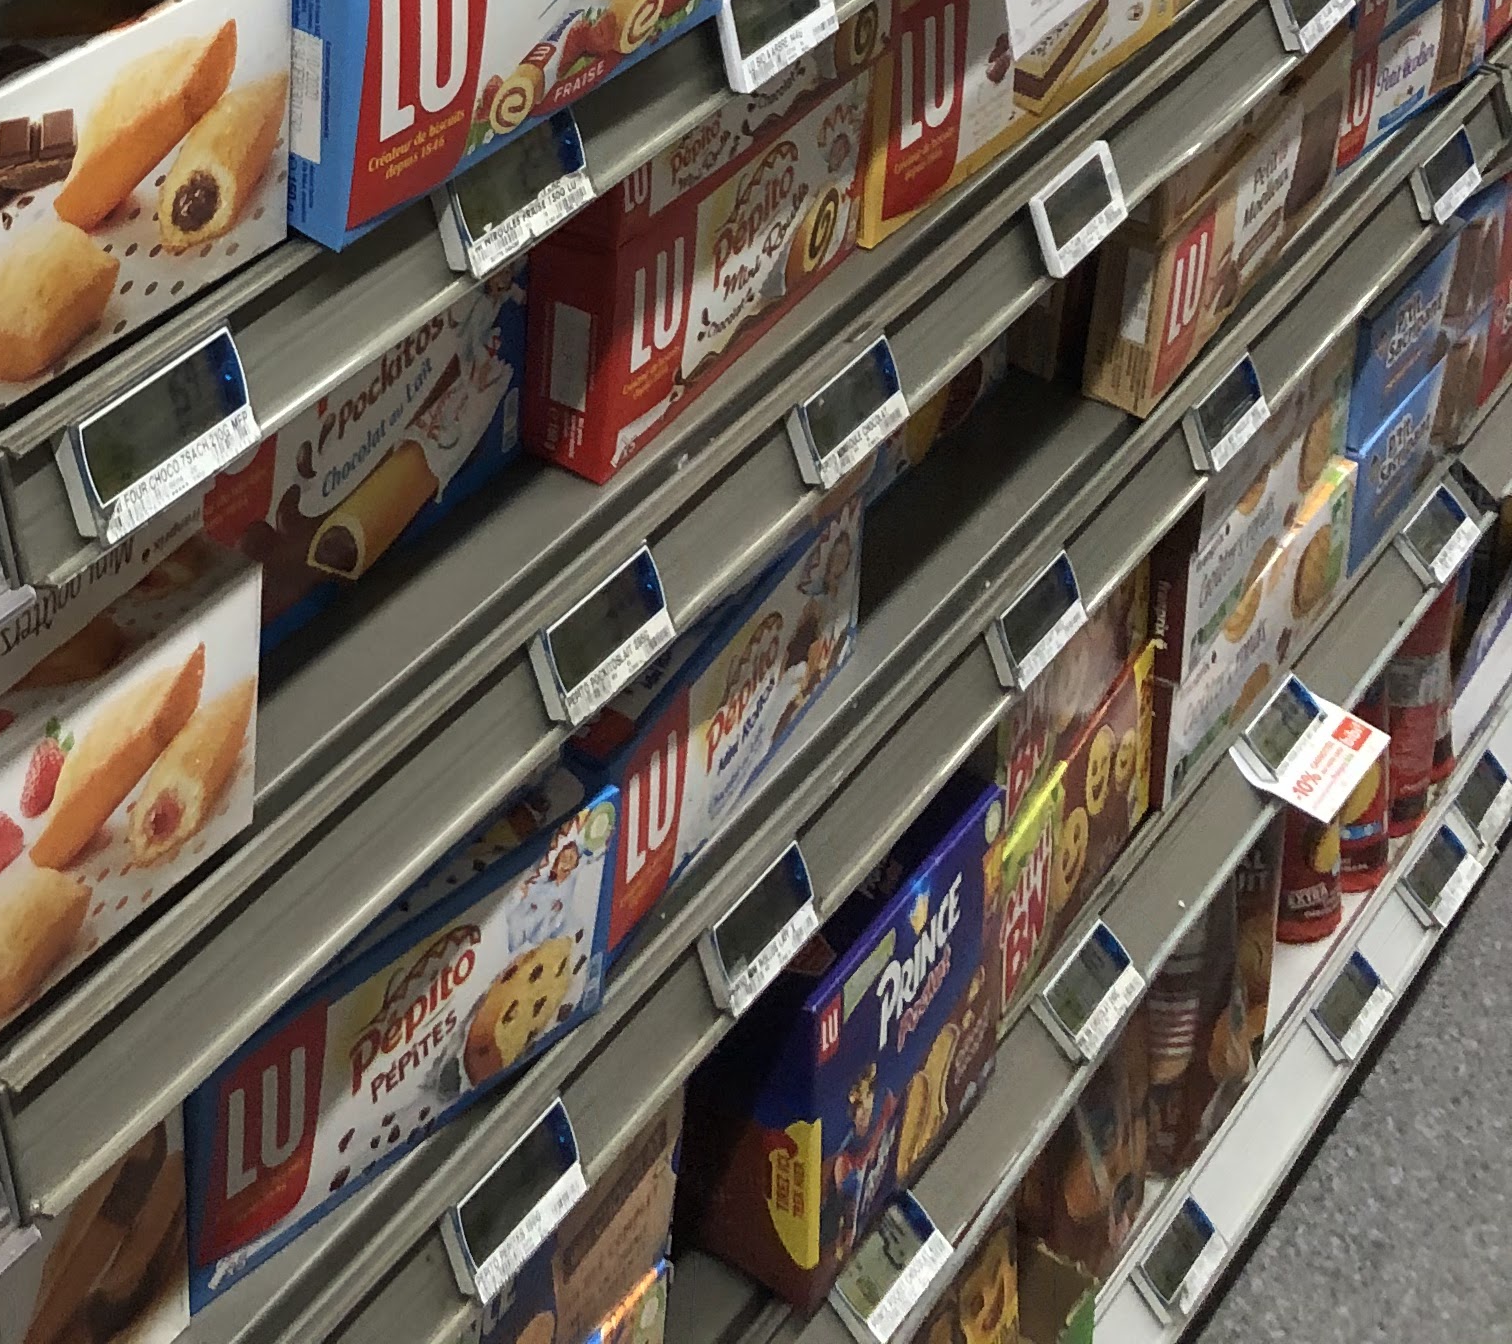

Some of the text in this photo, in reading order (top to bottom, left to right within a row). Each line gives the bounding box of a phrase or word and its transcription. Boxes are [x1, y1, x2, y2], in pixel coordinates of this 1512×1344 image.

[552, 61, 606, 105] FRAISE
[368, 130, 427, 175] Créateur de
[419, 135, 446, 161] 1846
[630, 235, 686, 375] LU
[1167, 231, 1213, 344] LU
[626, 729, 682, 885] LU
[348, 946, 477, 1096] Pépito
[879, 871, 963, 1050] PRINCE
[370, 1010, 459, 1106] PÉPITES
[224, 1045, 306, 1201] LU
